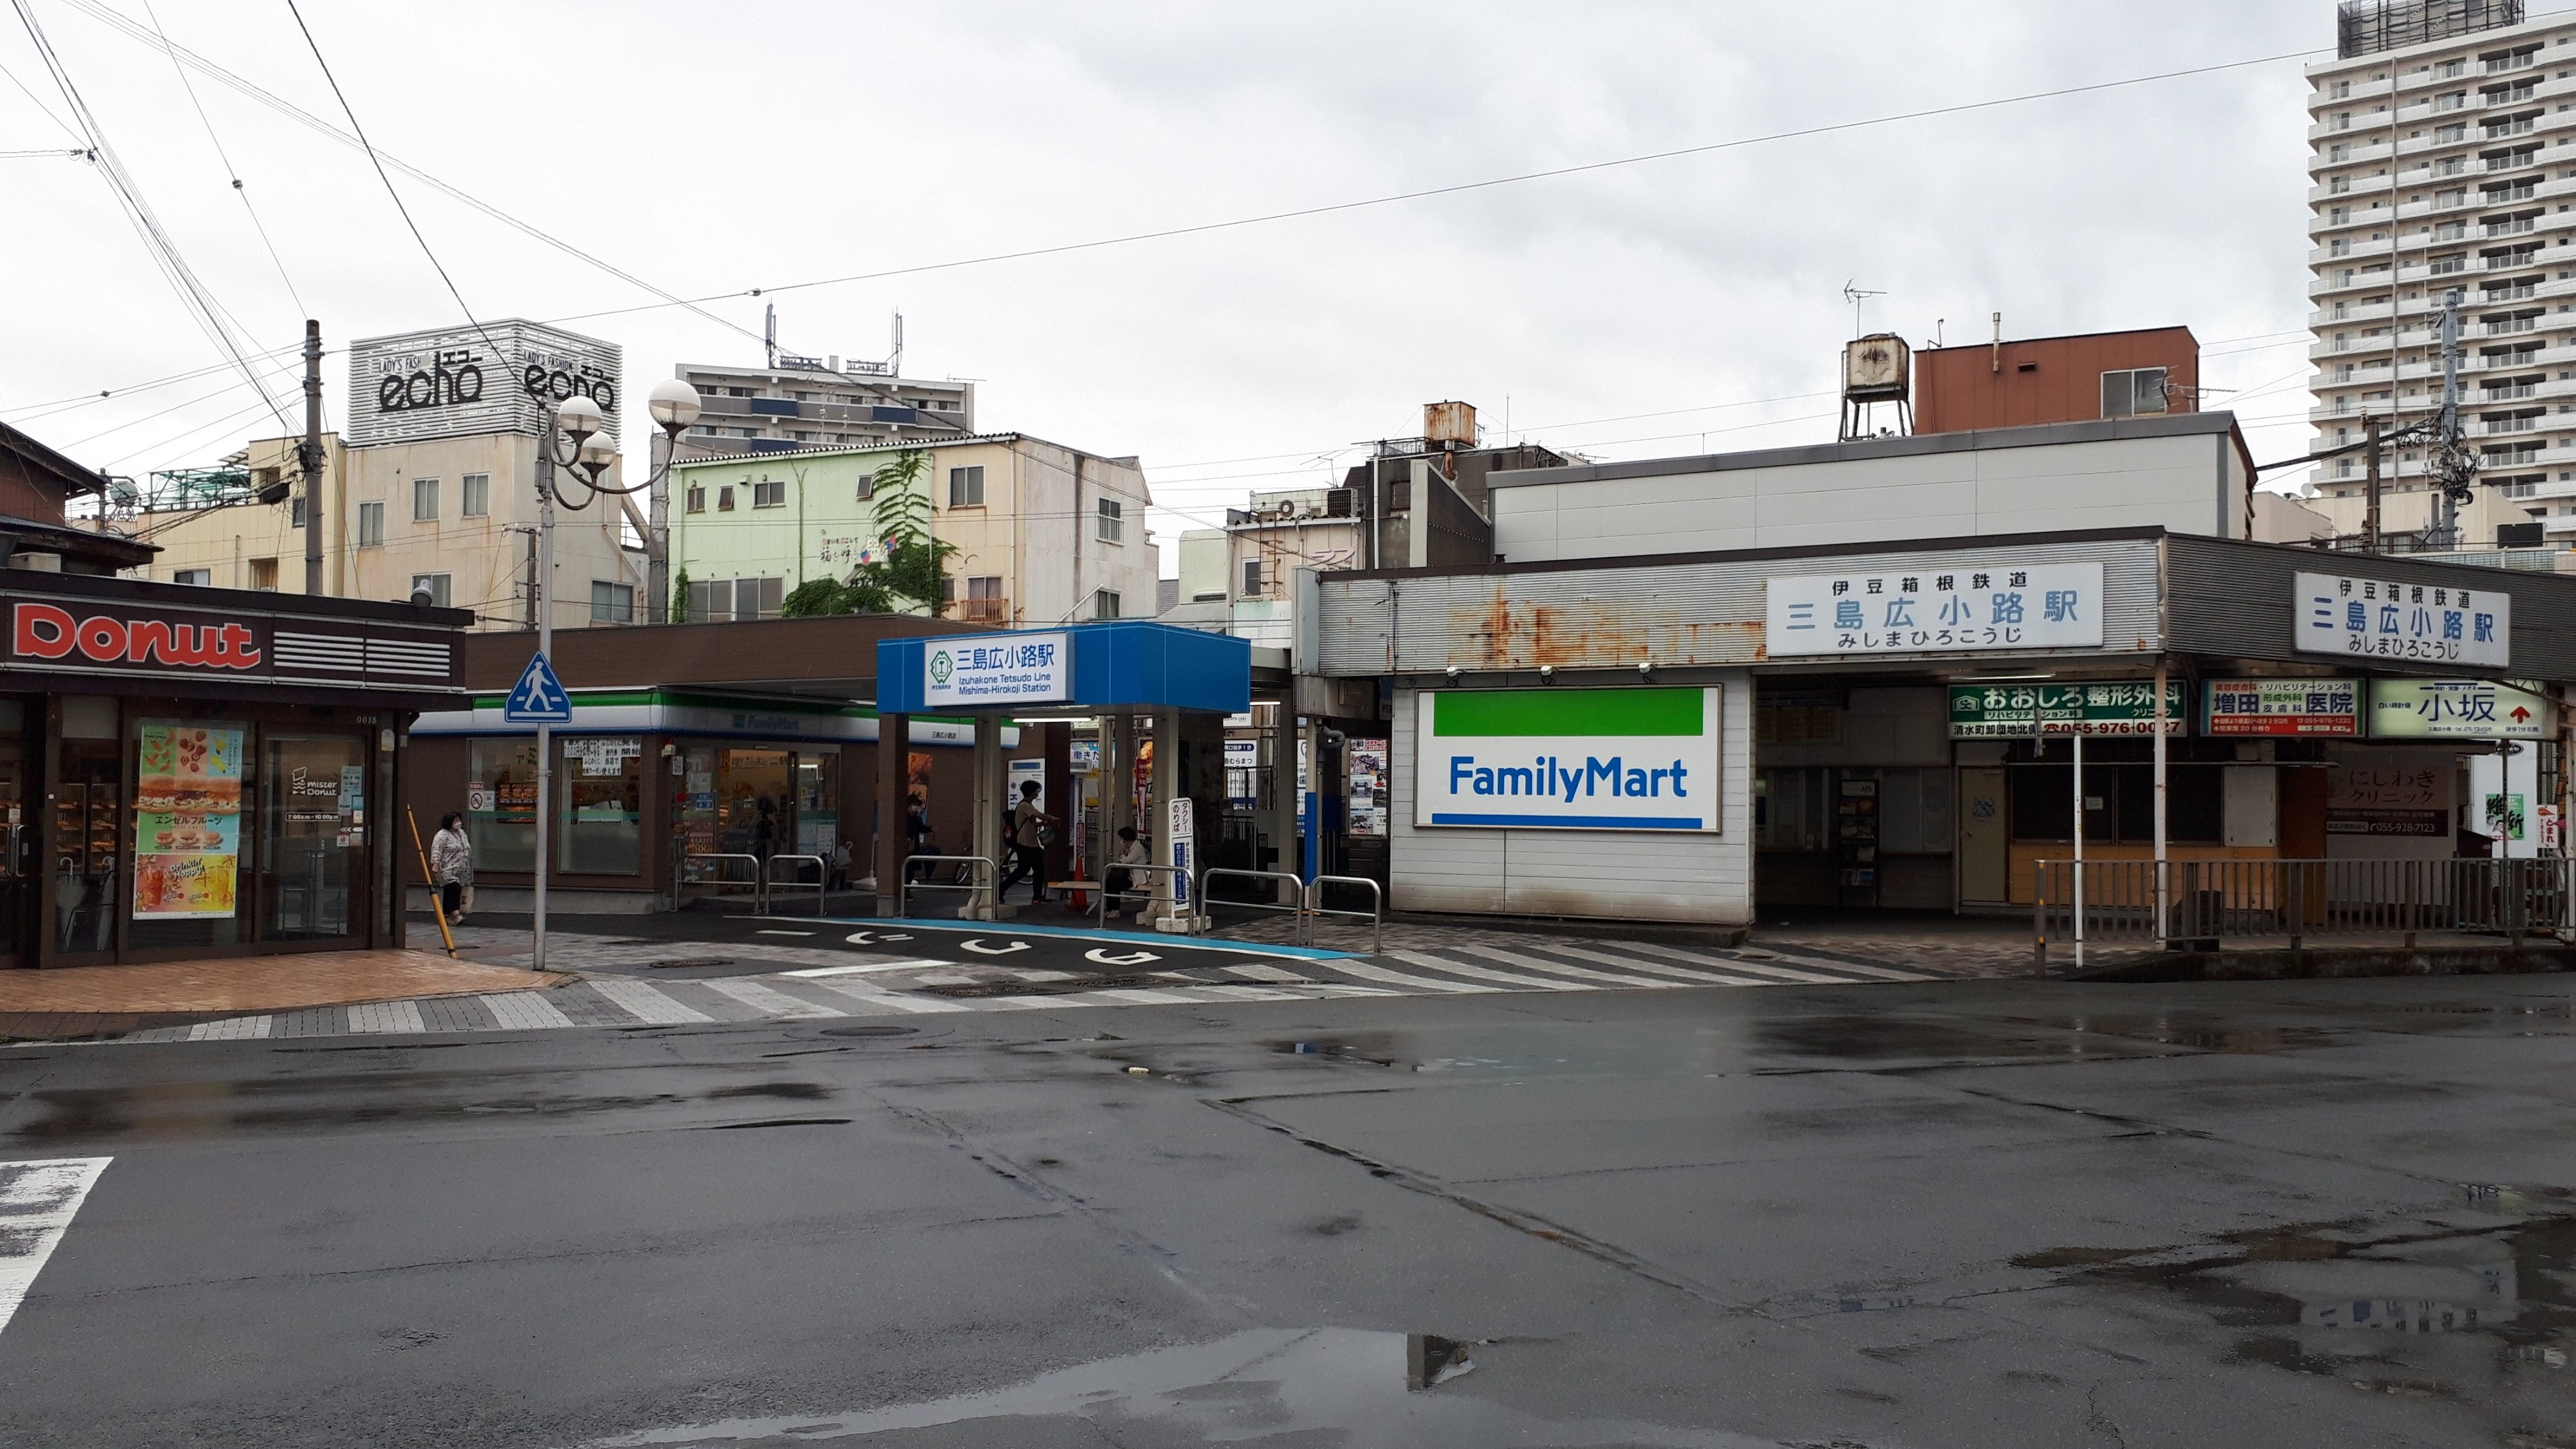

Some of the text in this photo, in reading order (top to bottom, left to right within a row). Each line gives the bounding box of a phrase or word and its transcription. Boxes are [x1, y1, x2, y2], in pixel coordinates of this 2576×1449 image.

[379, 359, 403, 373] LADY'S
[443, 350, 483, 365] エコー
[379, 351, 483, 413] echo
[1832, 572, 2027, 596] 伊豆箱根鉄道
[2340, 579, 2470, 609] 伊豆箱根鉄道
[1786, 590, 2077, 631] 三島広小路駅
[2312, 596, 2494, 644] 三島広小路駅
[12, 603, 262, 670] Donut
[1837, 626, 2022, 648] みしまひろこうじ
[957, 644, 1055, 670] 三島広小路駅
[2348, 634, 2460, 661] みしまひろこうじ
[959, 672, 1051, 686] Izuhakone Tetsudo Line
[959, 683, 1051, 695] Mishima-Hirokoji Station
[2214, 693, 2259, 714] 増田
[2263, 693, 2302, 702] 形成外科
[2305, 692, 2353, 714] 医院
[2417, 694, 2496, 722] 小坂
[2131, 708, 2172, 717] クリニク
[2263, 704, 2302, 713] 皮膚科
[356, 716, 377, 724] 0038
[1450, 756, 1688, 803] FamilyMart
[2349, 770, 2435, 788] にしわき
[2350, 789, 2435, 804] クリニック
[155, 815, 222, 826] エンゼルフルーツ
[2376, 823, 2435, 833] 055-928-7123
[2546, 818, 2555, 843] とまれ
